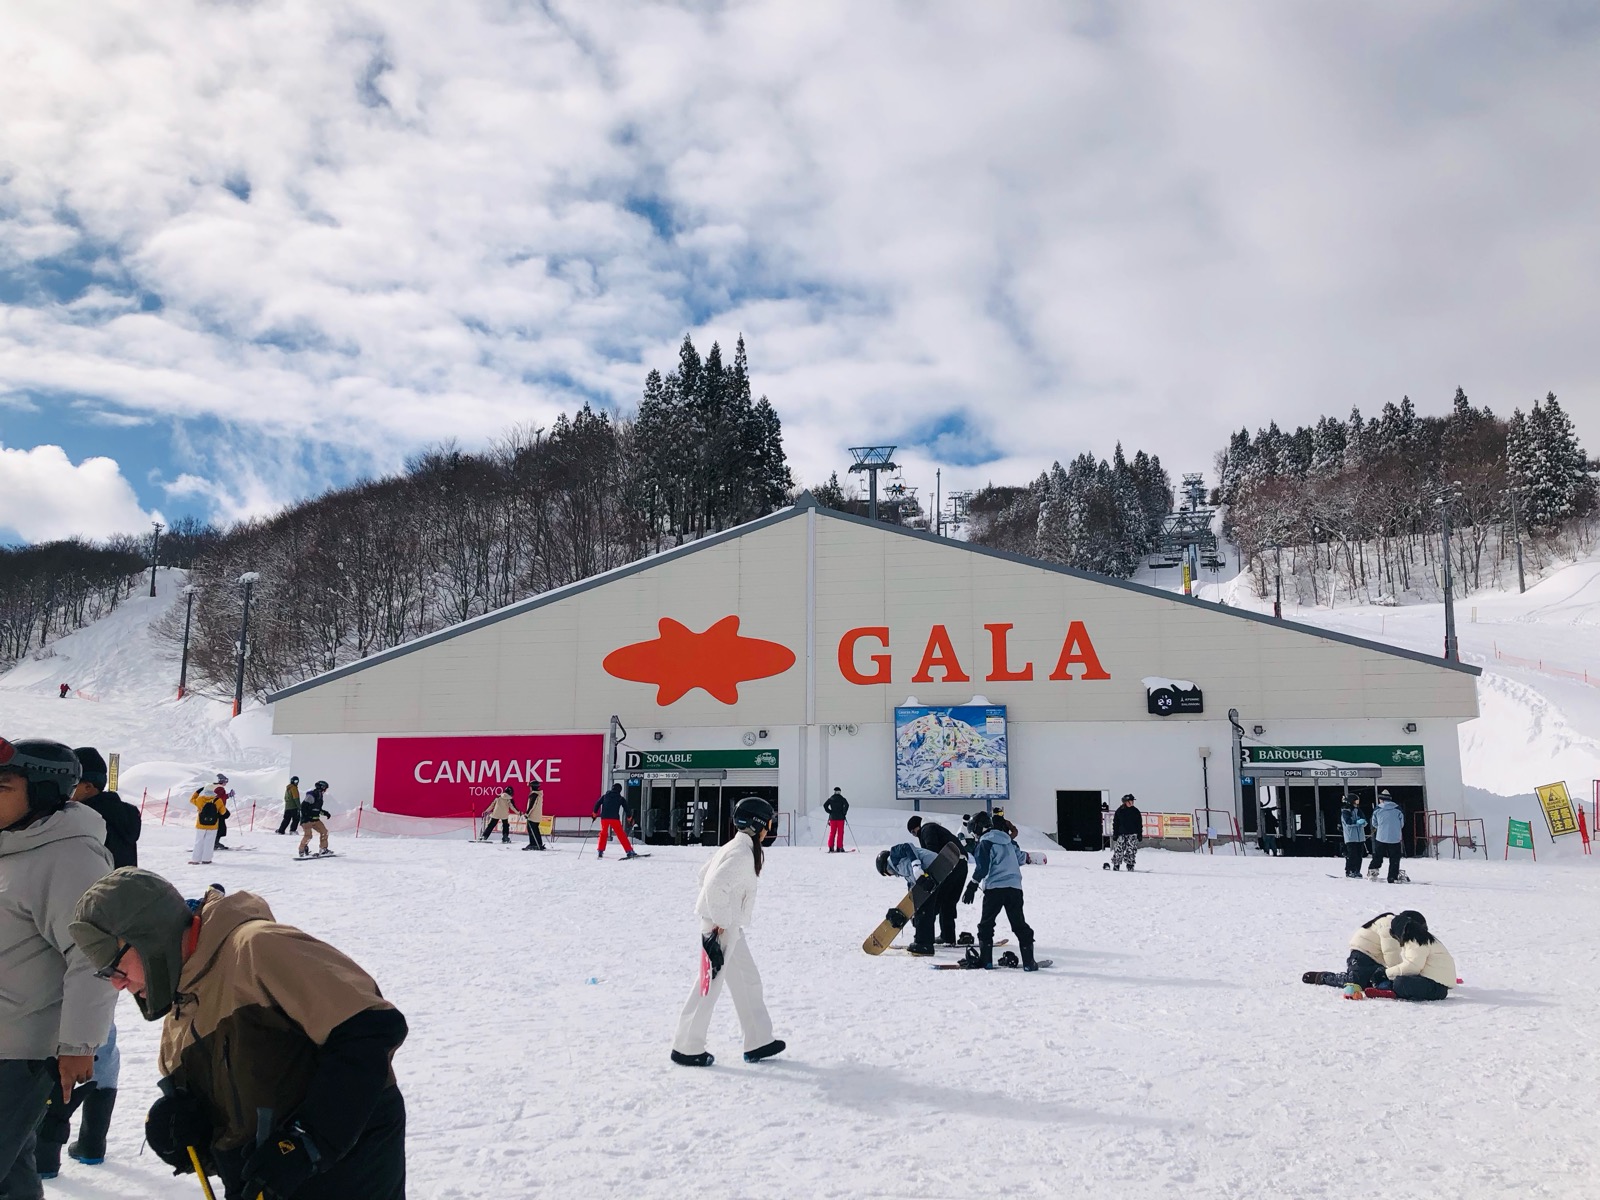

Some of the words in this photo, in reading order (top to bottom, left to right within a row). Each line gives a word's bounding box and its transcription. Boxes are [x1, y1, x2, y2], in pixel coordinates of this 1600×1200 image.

[838, 621, 1111, 685] GALA
[627, 753, 641, 768] D
[646, 753, 692, 763] SOCIABLE
[1259, 750, 1323, 760] BAROUCHE
[23, 762, 70, 775] GIRO
[414, 758, 562, 783] CANMAKE
[468, 786, 504, 797] TOKYO
